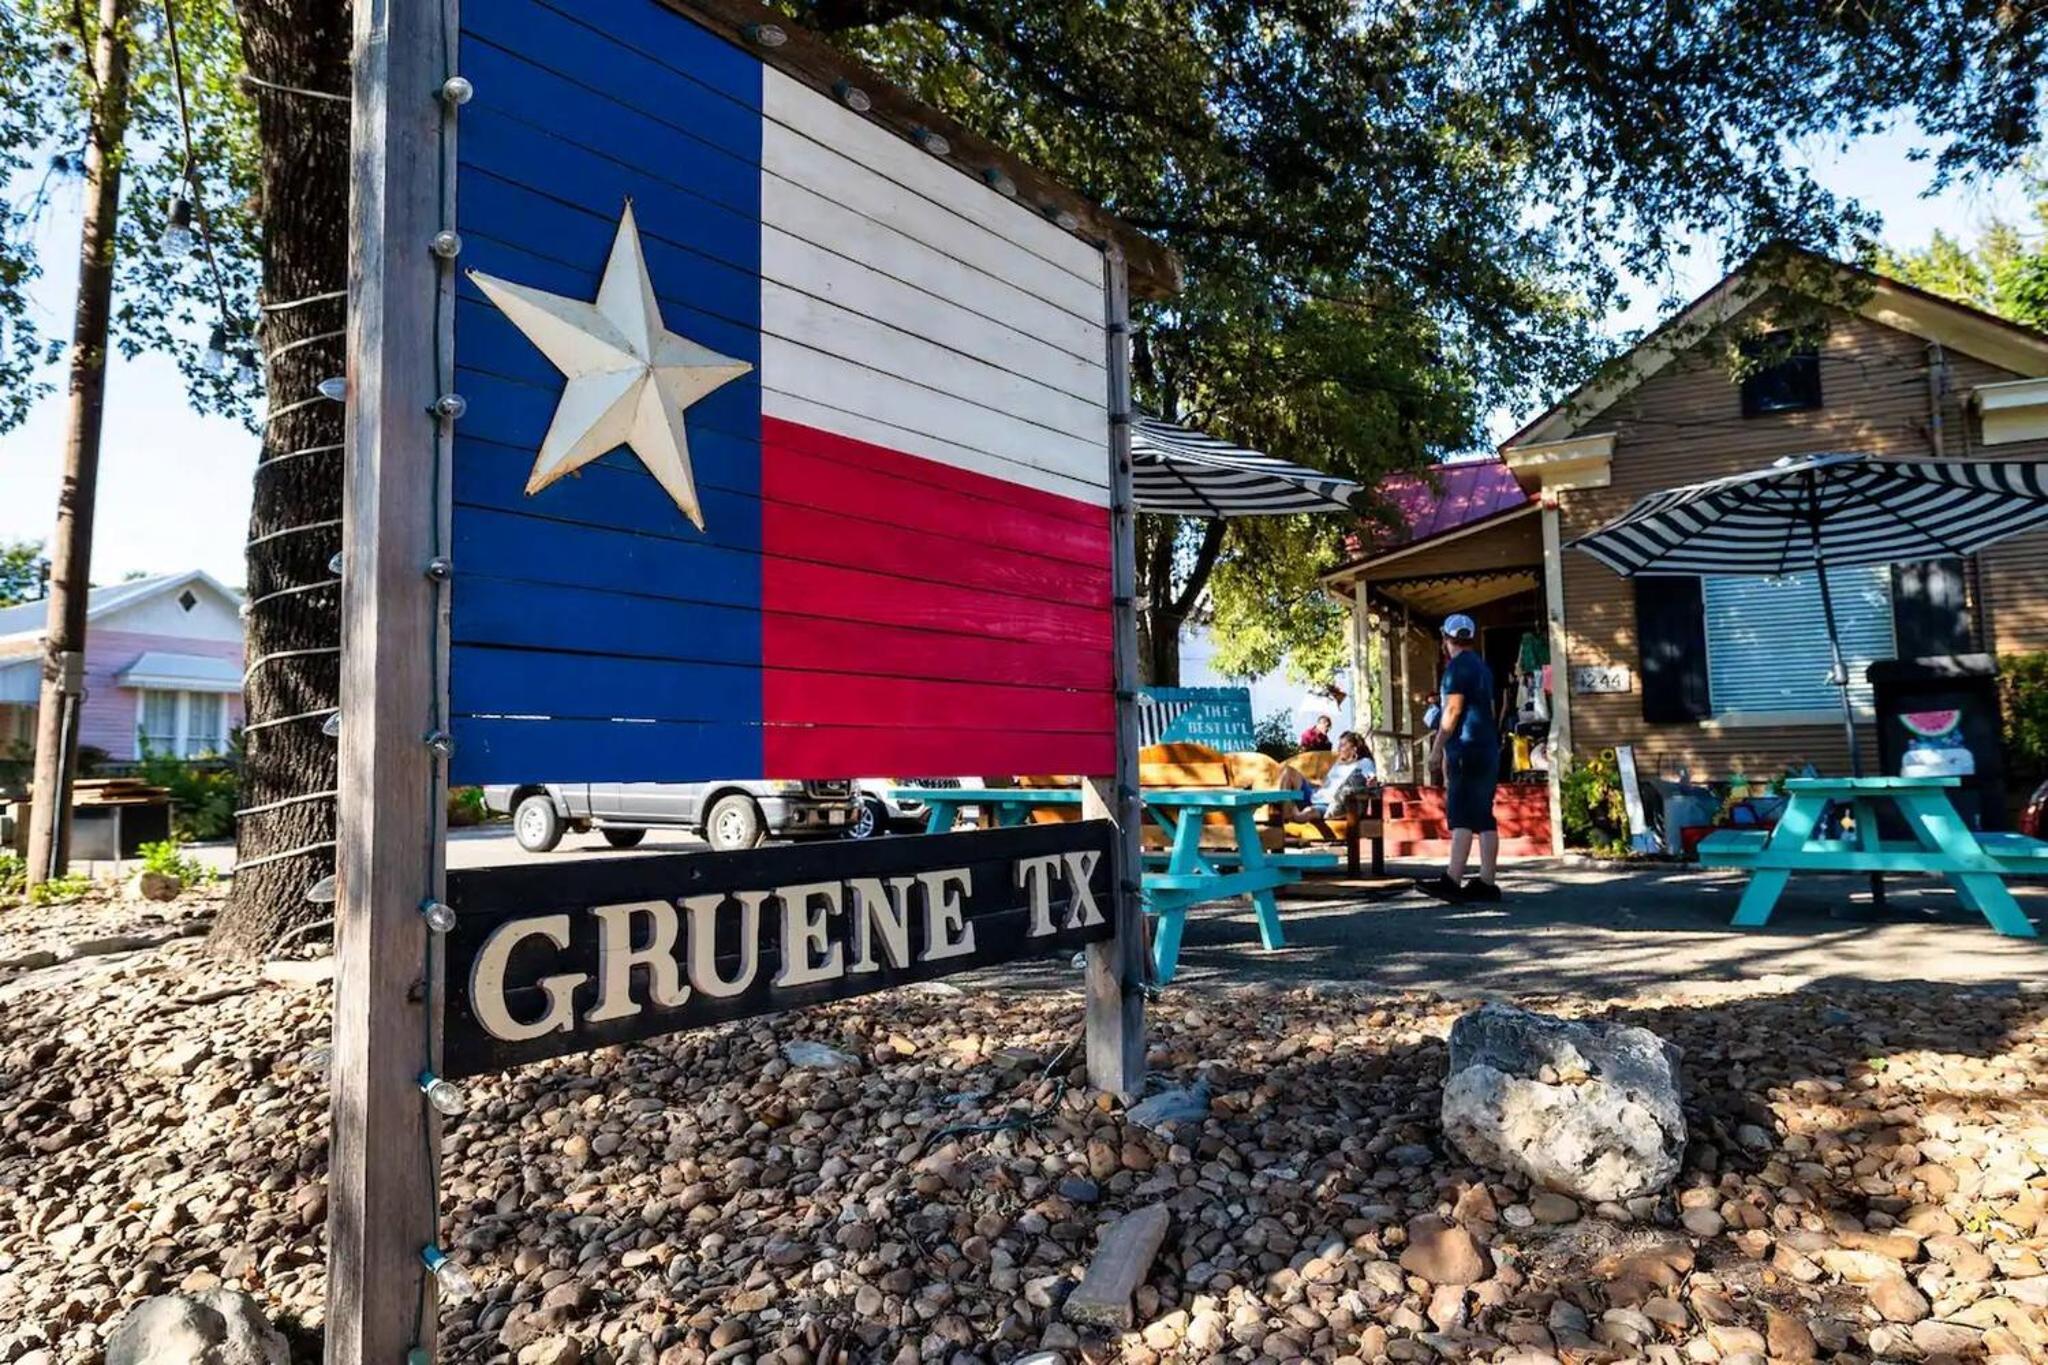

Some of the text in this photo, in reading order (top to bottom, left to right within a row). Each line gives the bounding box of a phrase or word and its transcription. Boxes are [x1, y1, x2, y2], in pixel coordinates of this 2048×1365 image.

[1580, 673, 1621, 689] 1244
[1202, 704, 1231, 717] THE
[1188, 721, 1250, 734] BEST LI'L
[470, 850, 1107, 1042] GRUENE TX
